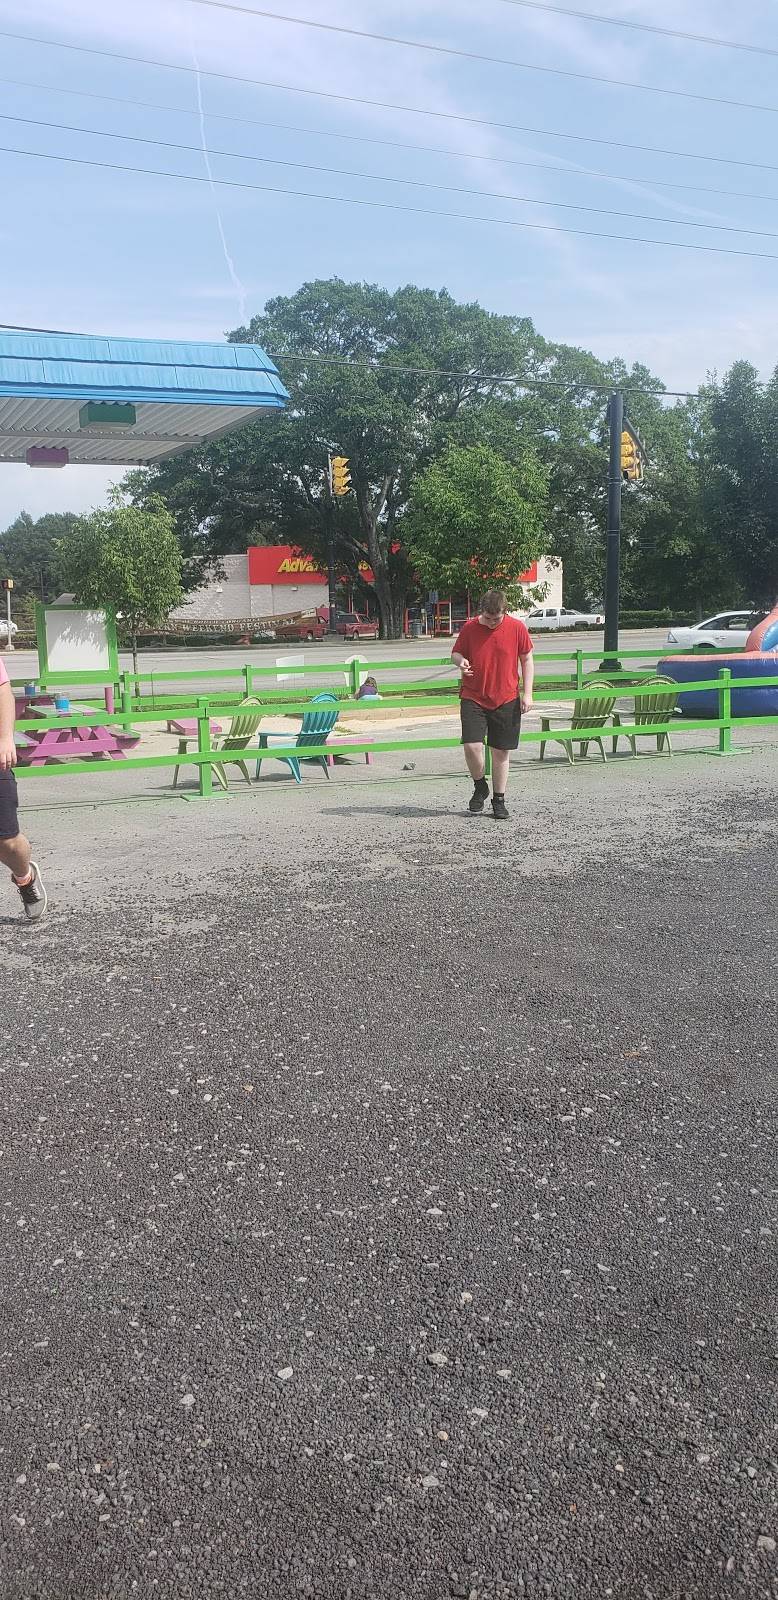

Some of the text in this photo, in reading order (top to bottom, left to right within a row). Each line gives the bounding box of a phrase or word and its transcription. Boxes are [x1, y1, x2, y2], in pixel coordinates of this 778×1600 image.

[277, 558, 331, 573] Adva
[182, 623, 235, 633] WEEKEND
[240, 618, 296, 632] FESTIVAL
